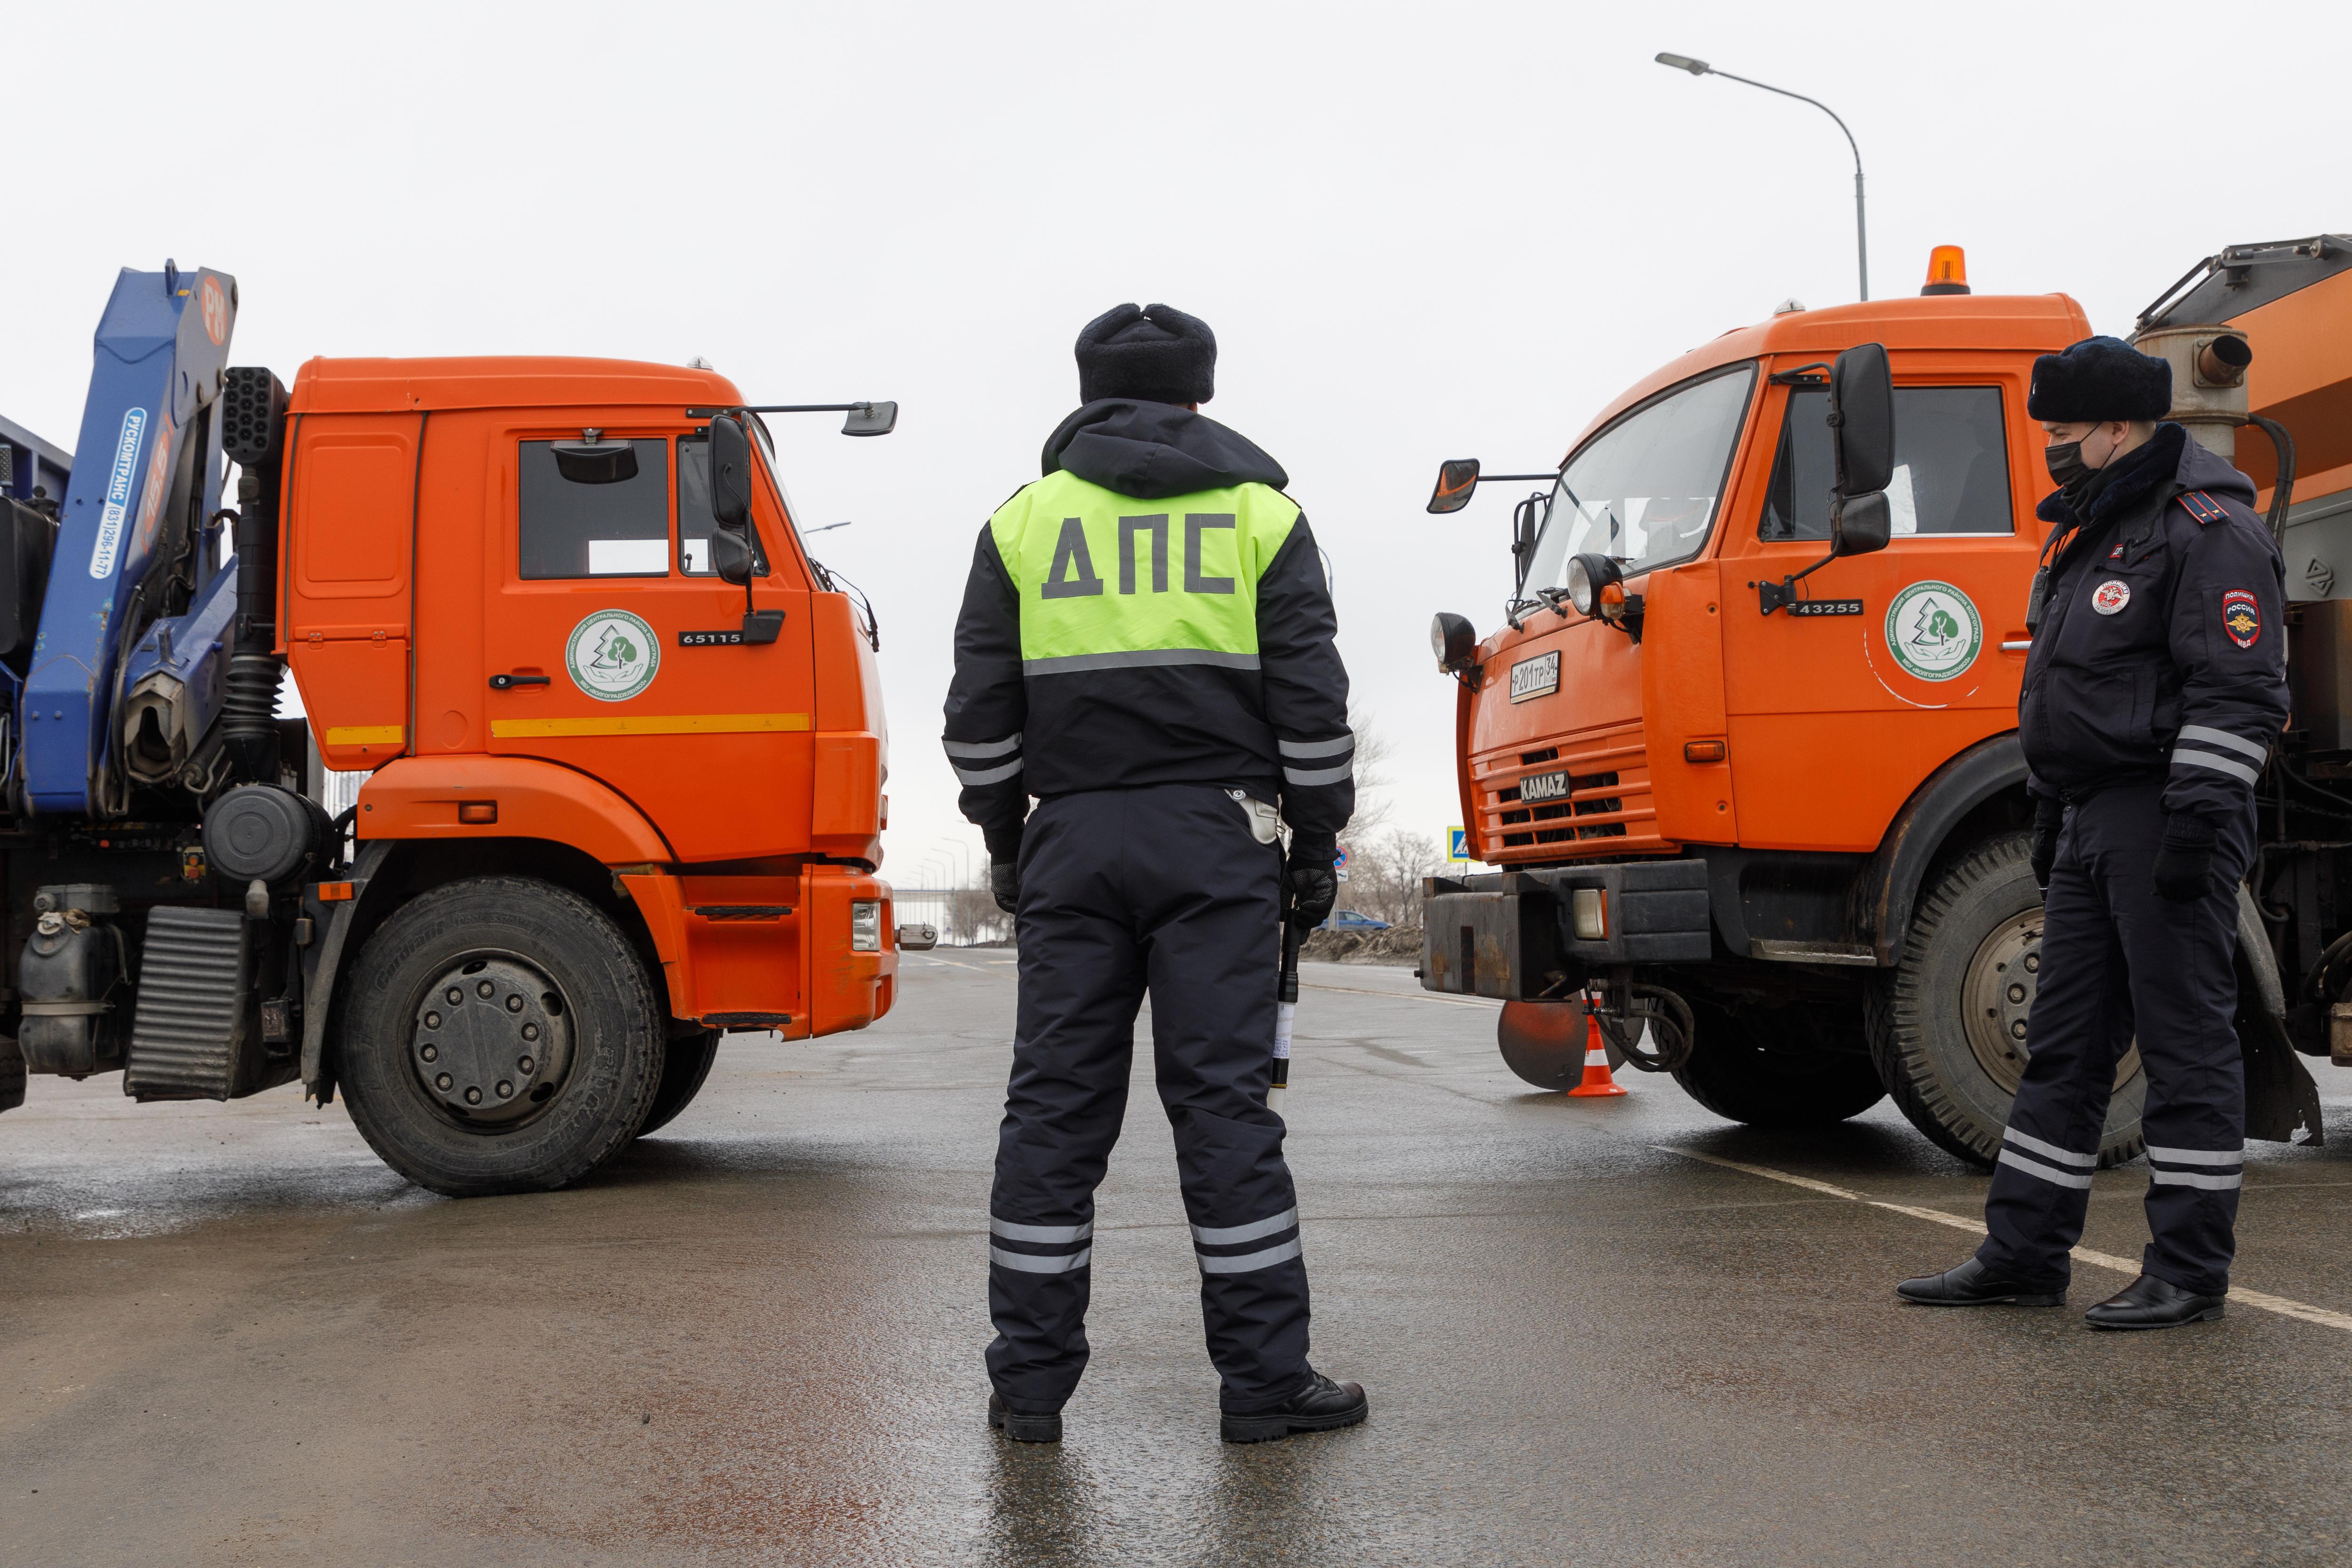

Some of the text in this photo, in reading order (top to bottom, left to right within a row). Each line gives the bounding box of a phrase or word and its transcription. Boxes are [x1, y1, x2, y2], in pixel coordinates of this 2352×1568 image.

[204, 284, 225, 341] PM
[95, 415, 142, 575] РУСКОМТРАНС (831)296-11-77
[1041, 514, 1236, 599] ДПС
[2103, 581, 2129, 594] ПОЛИЦИЯ
[2225, 592, 2254, 602] ПОЛИЦИЯ
[1800, 604, 1859, 613] 43255
[1889, 585, 1979, 646] АДМИНИСТРАЦИЯ ЦЕНТРАЛЬНОГО РАЙОНА ВОЛГОГРАДА
[2227, 604, 2255, 615] РОССИЯ
[568, 613, 657, 669] АДМИНИСТРАЦИЯ ЦЕНТРАЛЬНОГО РАЙОНА ВОЛГОГРАДА
[683, 634, 740, 643] 65115
[2238, 639, 2251, 648] МВД
[1546, 656, 1555, 675] 34
[1902, 657, 1971, 678] МБУ «ВОЛГОГРАДЗЕЛЕНХОЗ»
[580, 680, 647, 699] МБУ «ВОЛГОГРАДЗЕЛЕНХОЗ»
[1520, 774, 1566, 800] KAMAZ
